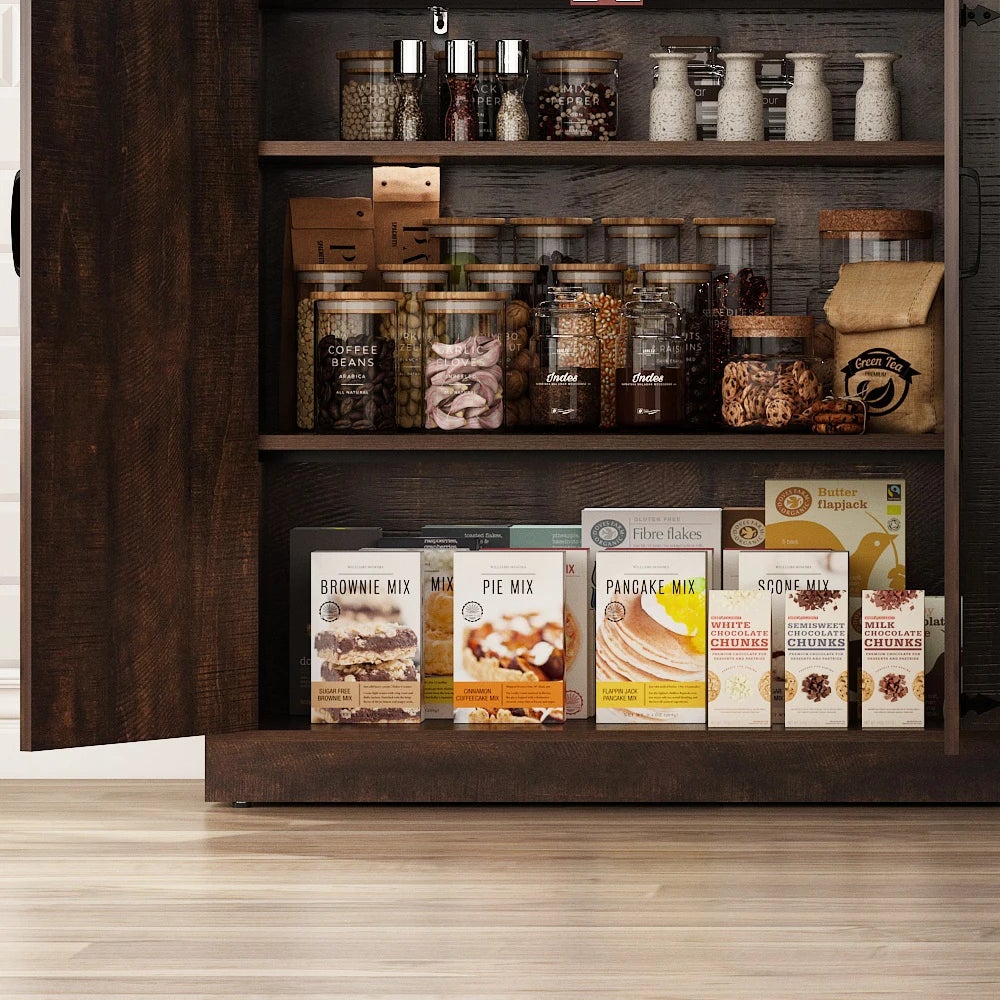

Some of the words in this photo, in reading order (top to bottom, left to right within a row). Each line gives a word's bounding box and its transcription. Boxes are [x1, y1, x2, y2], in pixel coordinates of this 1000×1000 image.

[564, 84, 586, 93] MIX
[552, 97, 600, 106] PEPPER
[328, 346, 378, 354] COFFEE
[332, 358, 374, 366] BEANS
[855, 358, 882, 369] Green
[886, 356, 903, 372] Tea
[818, 488, 858, 496] Butter
[780, 500, 810, 516] ORGANIC
[817, 500, 868, 511] flapjack
[633, 527, 664, 539] Fibre
[667, 526, 702, 539] flakes
[594, 536, 623, 546] ORGANIC
[566, 564, 575, 574] IX
[321, 580, 380, 594] BROWNIE
[388, 580, 410, 594] MIX
[432, 577, 454, 591] MIX
[483, 580, 503, 594] PIE
[511, 580, 533, 594] MIX
[606, 579, 665, 594] PANCAKE
[673, 579, 695, 594] MIX
[758, 580, 800, 594] SCONE
[807, 580, 829, 590] MIX
[711, 639, 768, 647] CHUNKS
[788, 639, 845, 647] CHUNKS
[864, 639, 922, 647] CHUNKS
